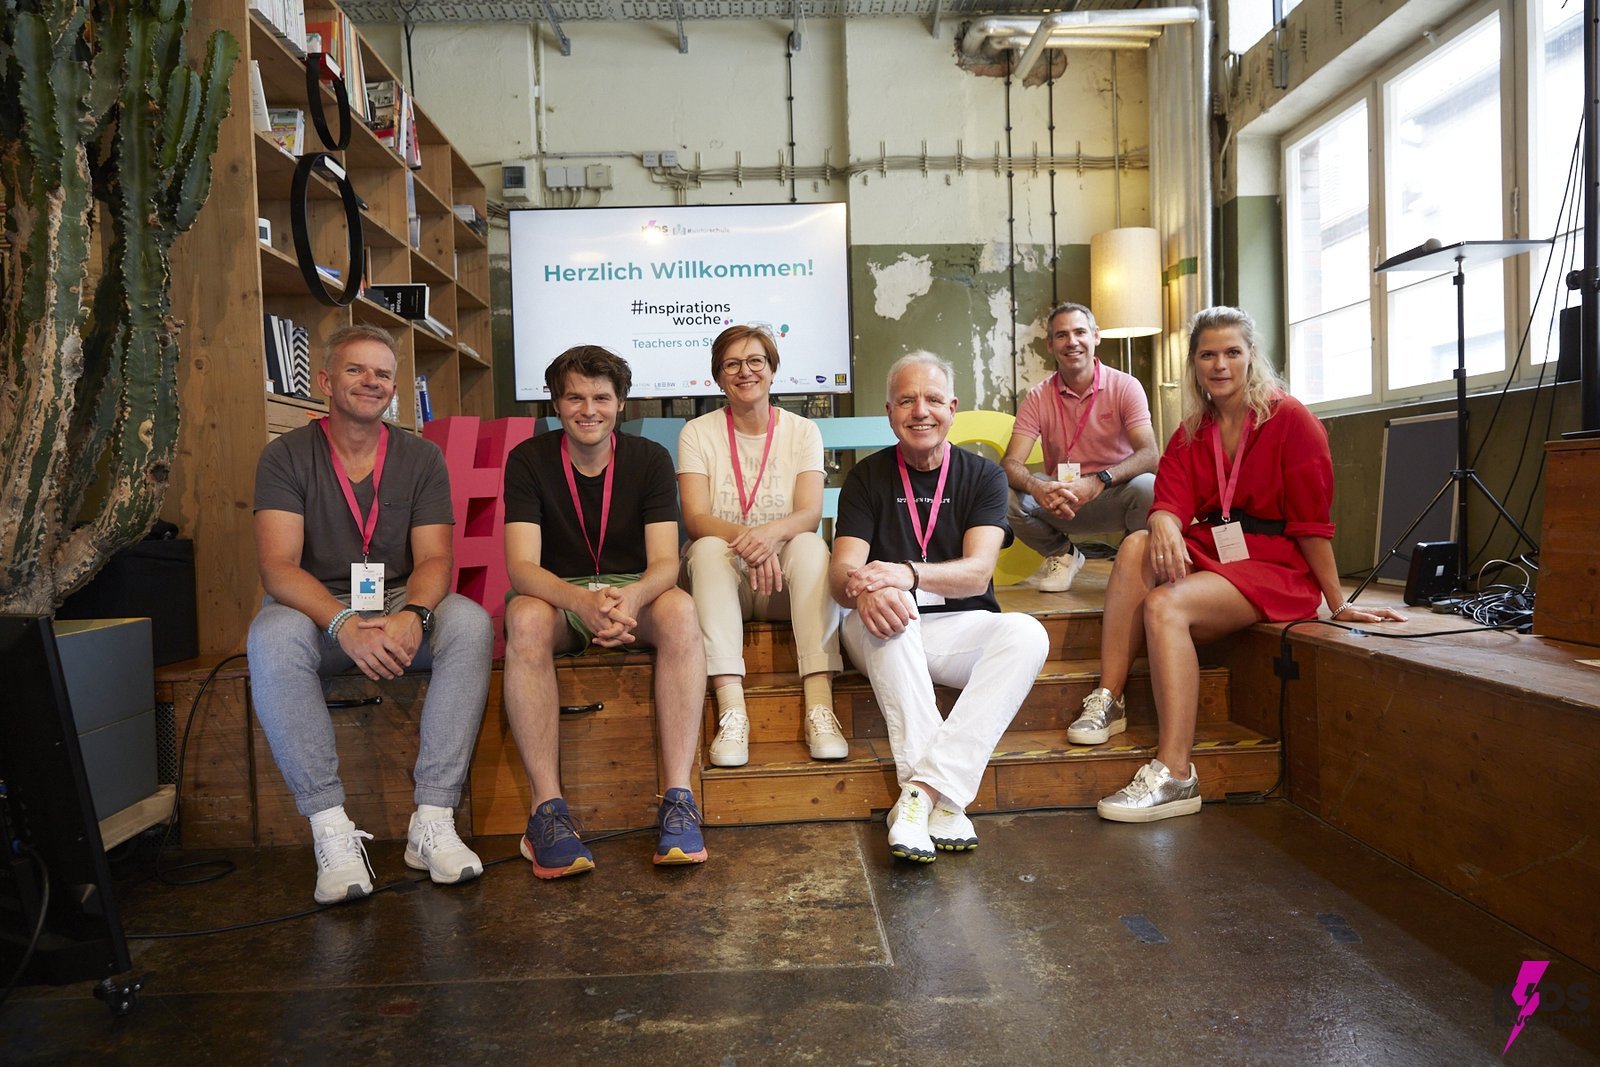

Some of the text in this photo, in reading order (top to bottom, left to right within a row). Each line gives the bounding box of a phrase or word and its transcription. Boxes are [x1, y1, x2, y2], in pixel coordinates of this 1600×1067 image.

[544, 258, 814, 283] Herzlich Willkommen!
[631, 299, 731, 319] #inspirations
[672, 312, 721, 326] woche
[632, 337, 682, 349] Teachers
[684, 339, 700, 348] on
[728, 455, 777, 471] HINK
[720, 491, 785, 509] THNGS
